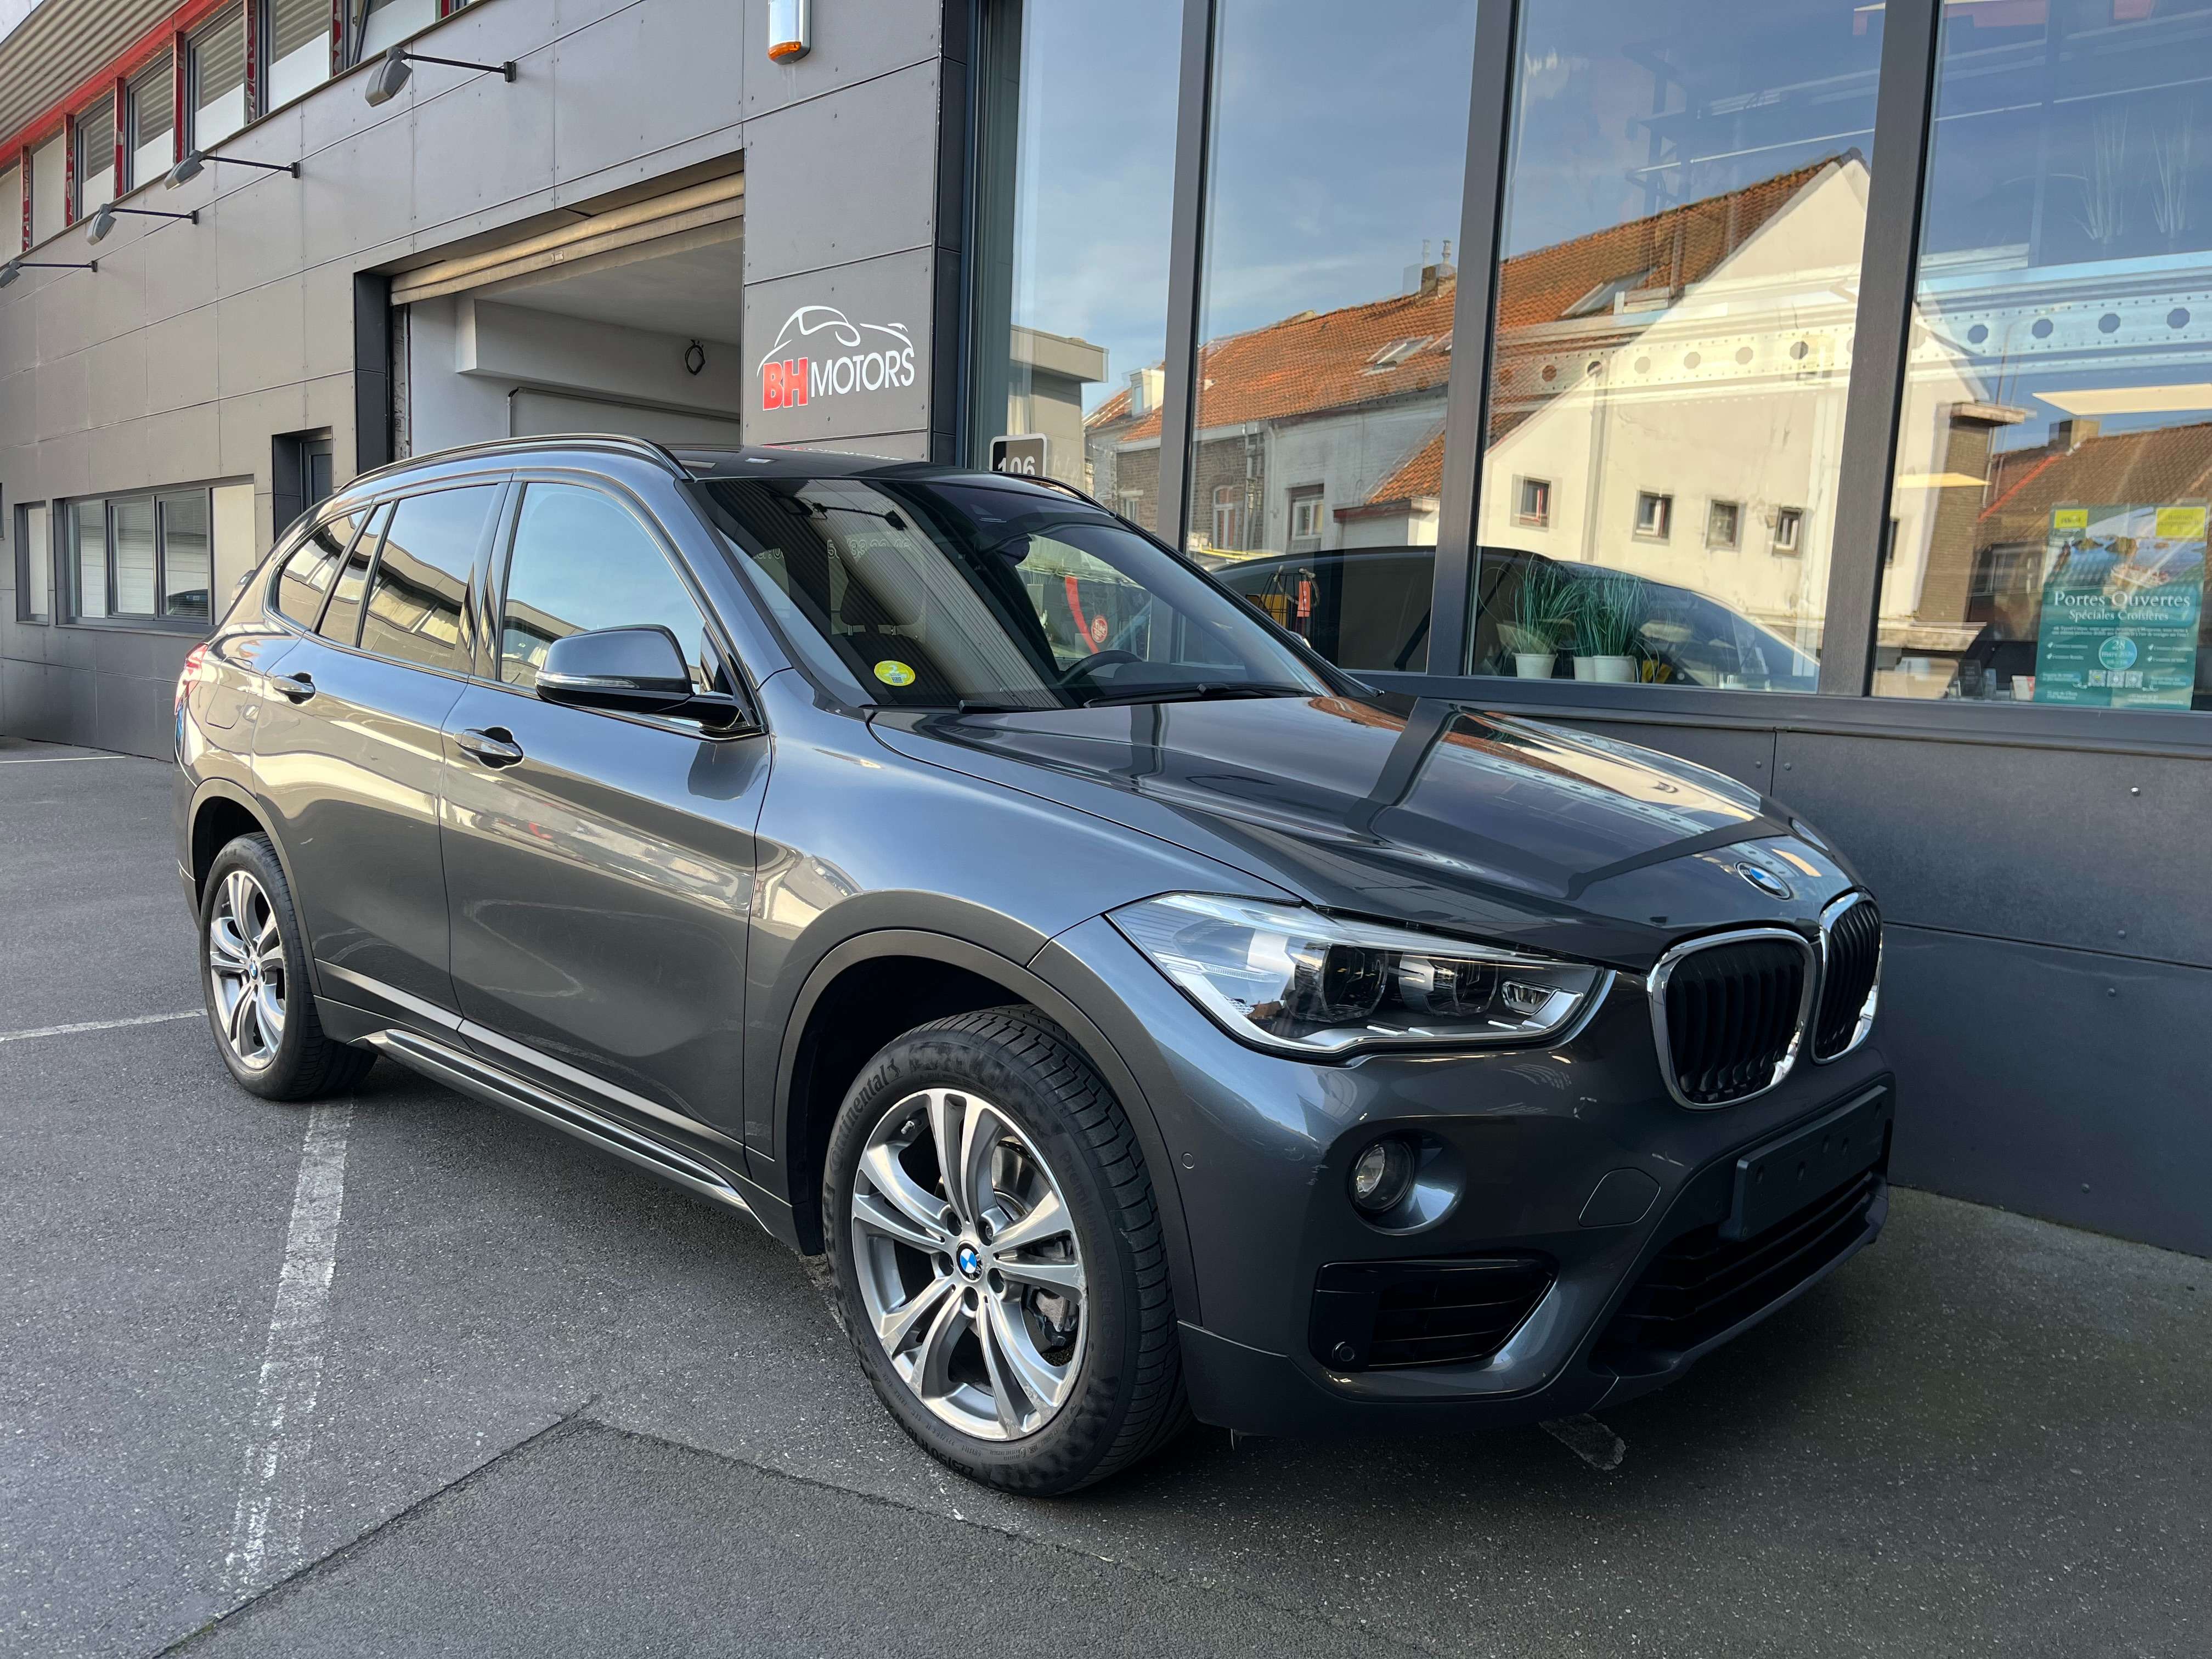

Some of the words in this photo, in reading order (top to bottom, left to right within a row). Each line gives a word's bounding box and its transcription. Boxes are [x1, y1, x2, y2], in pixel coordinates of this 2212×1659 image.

[762, 357, 809, 411] BH
[810, 347, 916, 398] MOTORS
[997, 456, 1035, 476] 106
[2054, 591, 2106, 607] Portes
[2112, 590, 2191, 607] Ouvertes
[2069, 608, 2114, 623] Spéciales
[2112, 639, 2126, 650] 28
[829, 1064, 890, 1175] Continental
